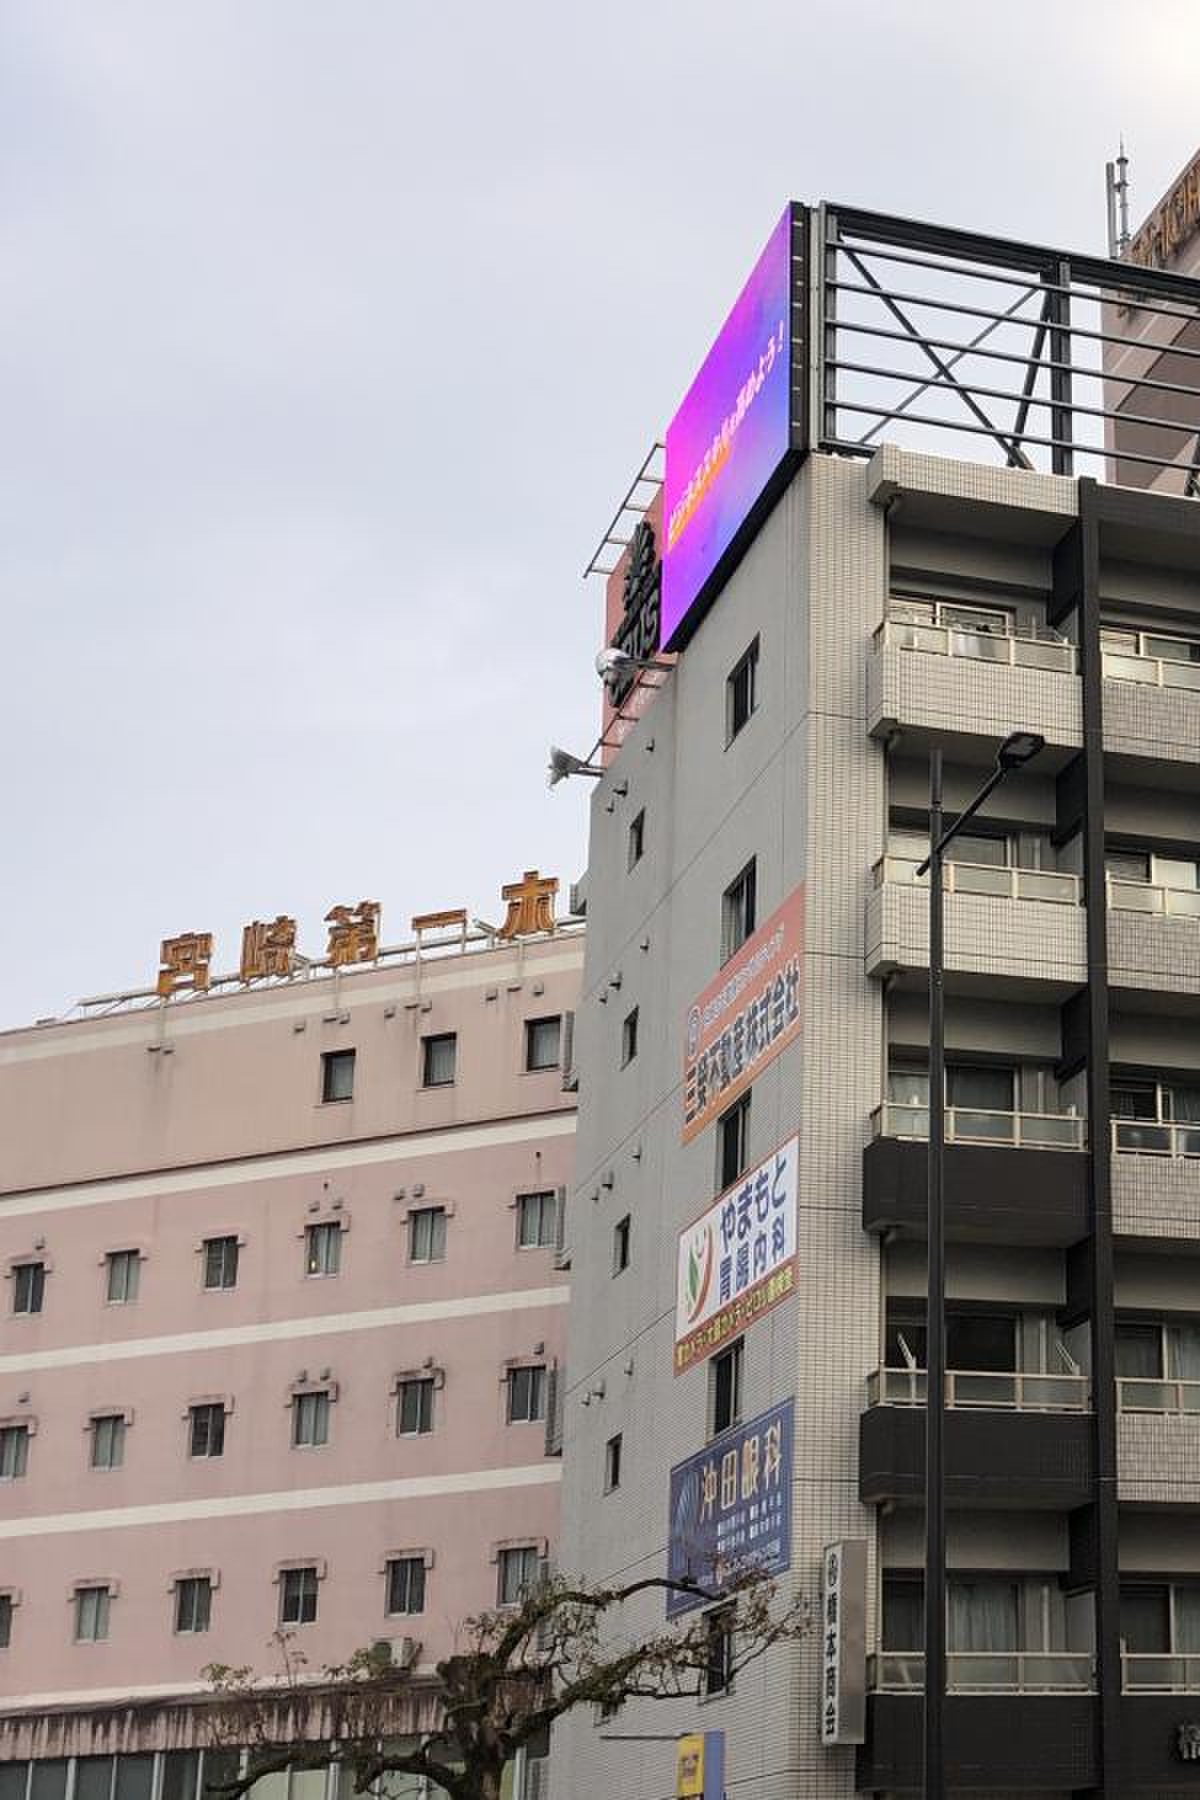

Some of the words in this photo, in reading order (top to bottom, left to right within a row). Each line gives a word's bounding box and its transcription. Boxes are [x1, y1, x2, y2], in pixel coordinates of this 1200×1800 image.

[719, 1154, 787, 1253] やまもと
[700, 1419, 782, 1524] 沖田眼科
